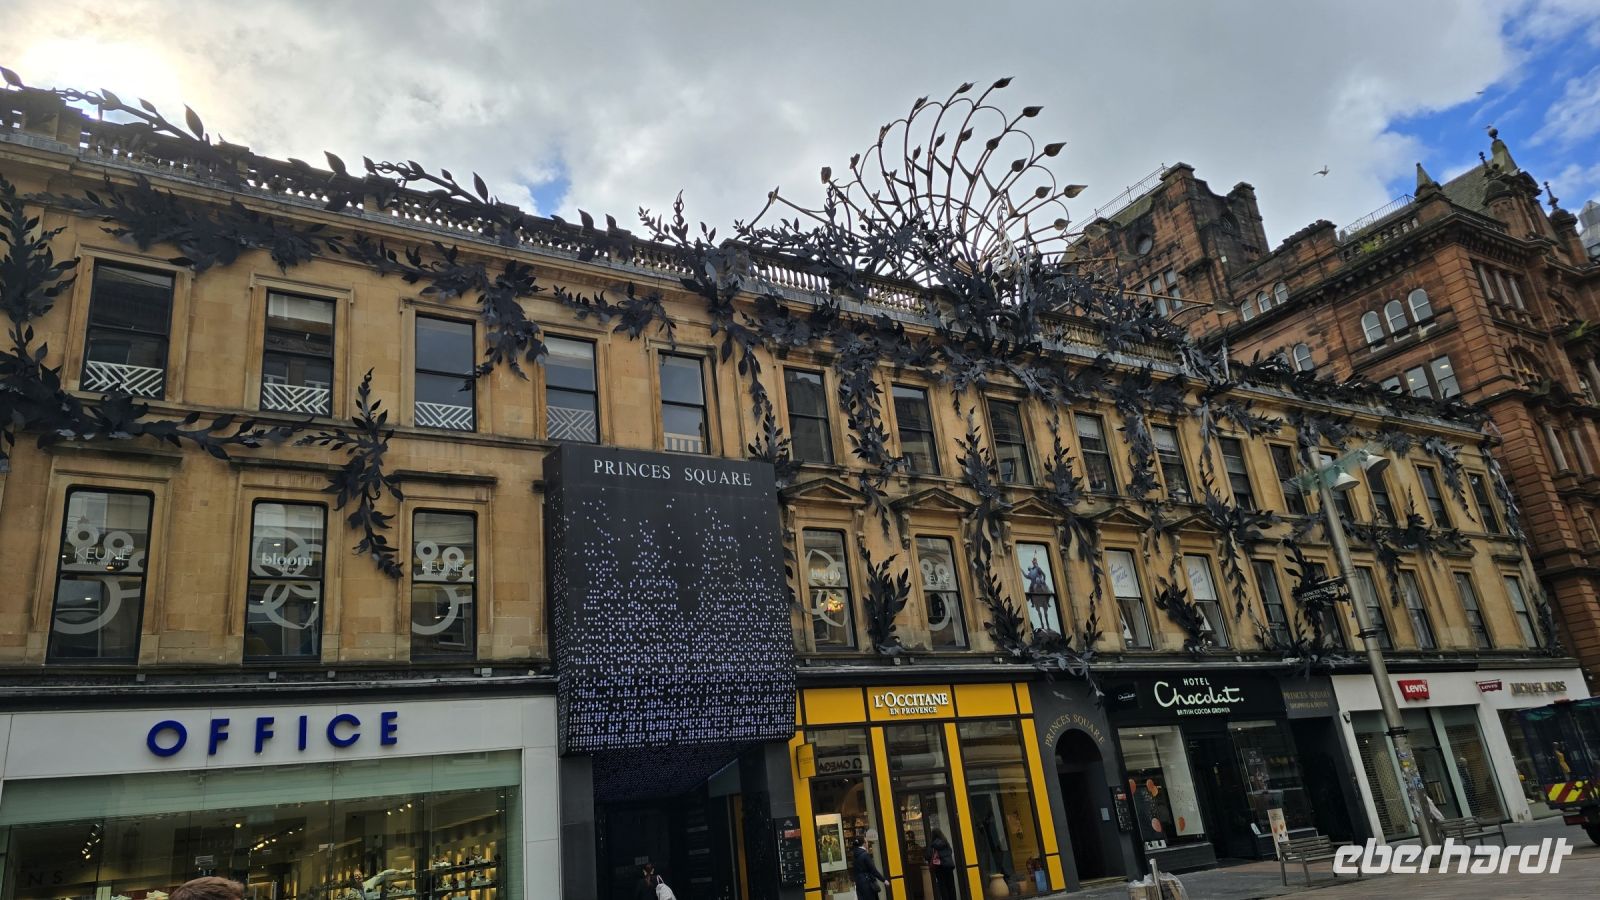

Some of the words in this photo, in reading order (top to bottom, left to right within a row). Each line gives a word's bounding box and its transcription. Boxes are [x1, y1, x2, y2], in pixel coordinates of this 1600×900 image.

[593, 459, 671, 480] PRINCES
[684, 467, 752, 486] SQUARE
[74, 546, 130, 560] KEUNE
[261, 552, 313, 567] bloom
[421, 560, 464, 572] KEUNE
[1182, 677, 1210, 686] HOTEL
[874, 691, 949, 708] L'OCCITANE
[889, 707, 900, 715] EN
[901, 706, 938, 715] PROVENCE
[146, 711, 399, 757] OFFICE
[1045, 713, 1071, 747] PRINCES
[1073, 715, 1105, 745] SQUARE
